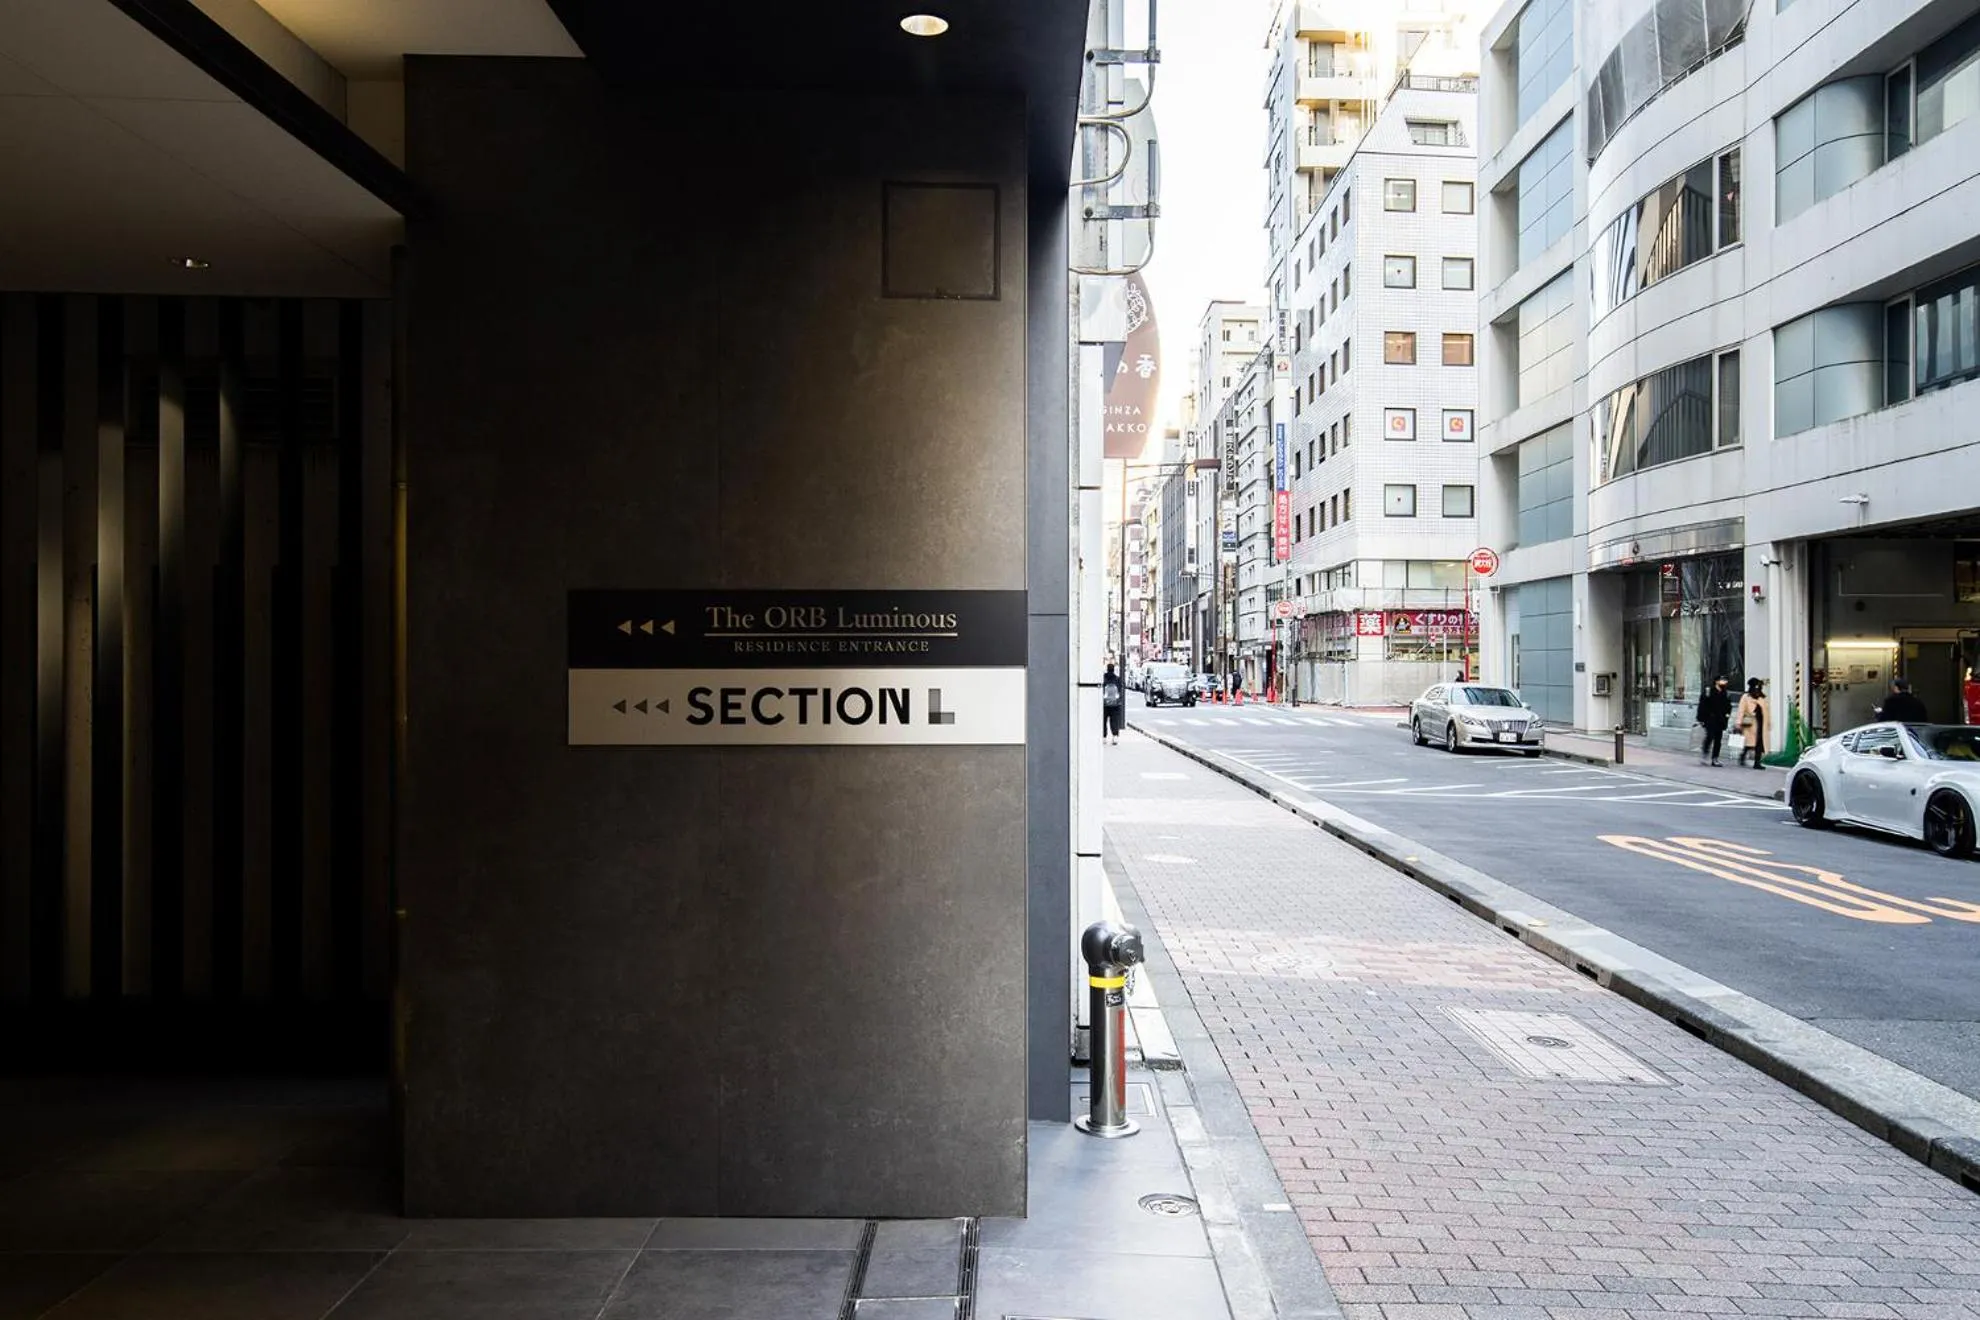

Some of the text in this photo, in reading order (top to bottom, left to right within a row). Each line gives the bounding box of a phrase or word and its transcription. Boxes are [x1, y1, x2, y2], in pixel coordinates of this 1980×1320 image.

[705, 606, 958, 629] The ORB Luminous
[1359, 613, 1382, 635] 薬
[734, 640, 930, 652] RESIDENCE ENTRANCE
[686, 687, 956, 726] SECTION L
